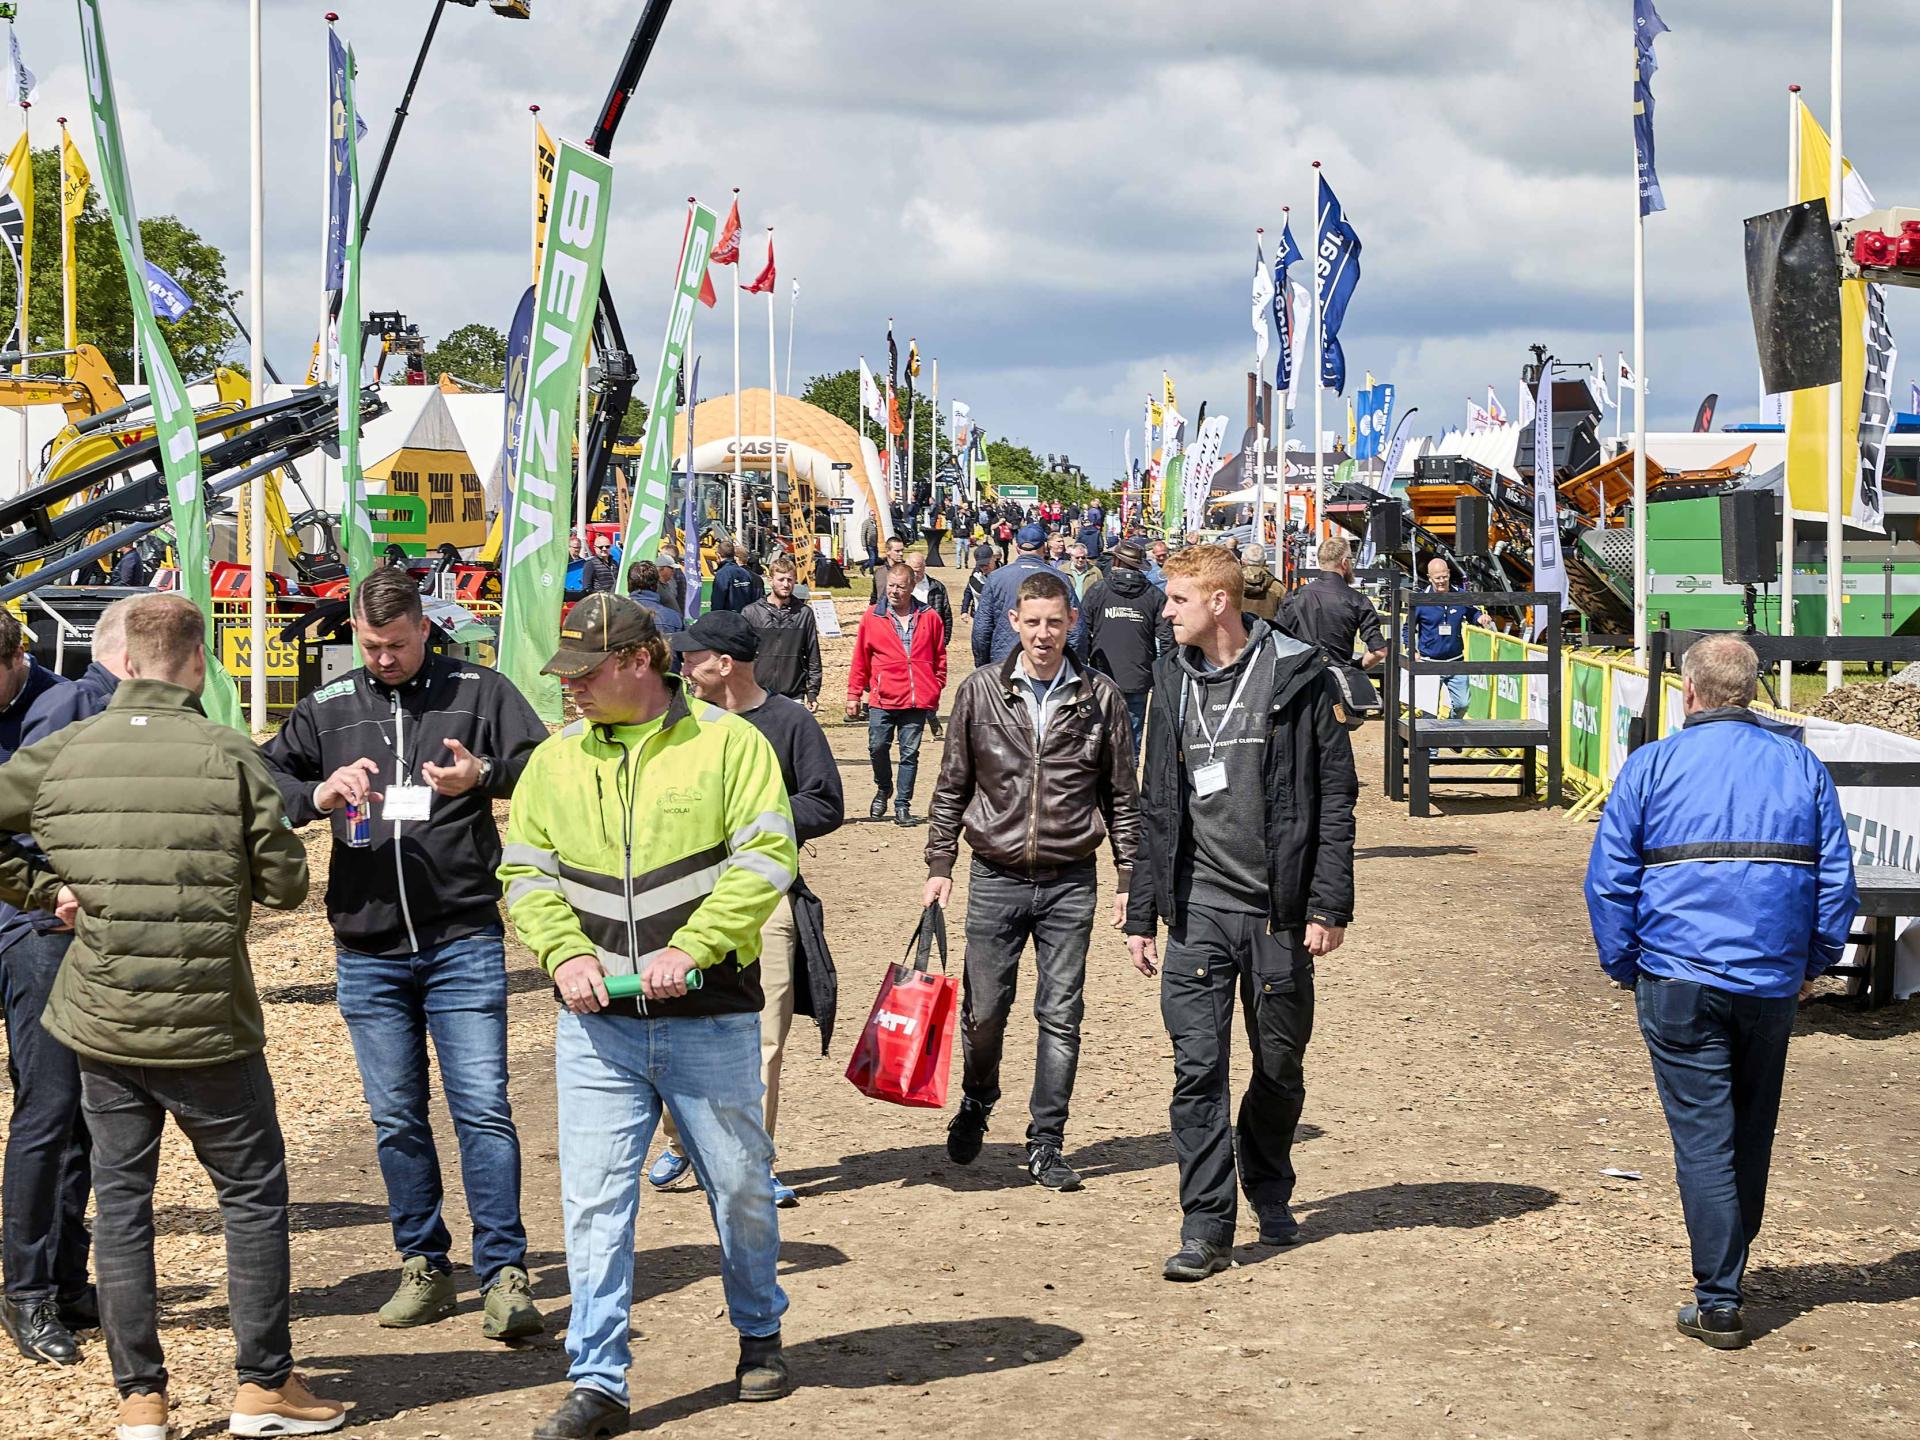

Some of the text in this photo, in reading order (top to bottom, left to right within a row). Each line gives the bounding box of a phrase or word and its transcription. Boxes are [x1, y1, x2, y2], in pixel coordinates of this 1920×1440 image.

[727, 441, 788, 455] CASE
[1505, 488, 1527, 507] MS-3
[663, 807, 690, 815] NICOLAI
